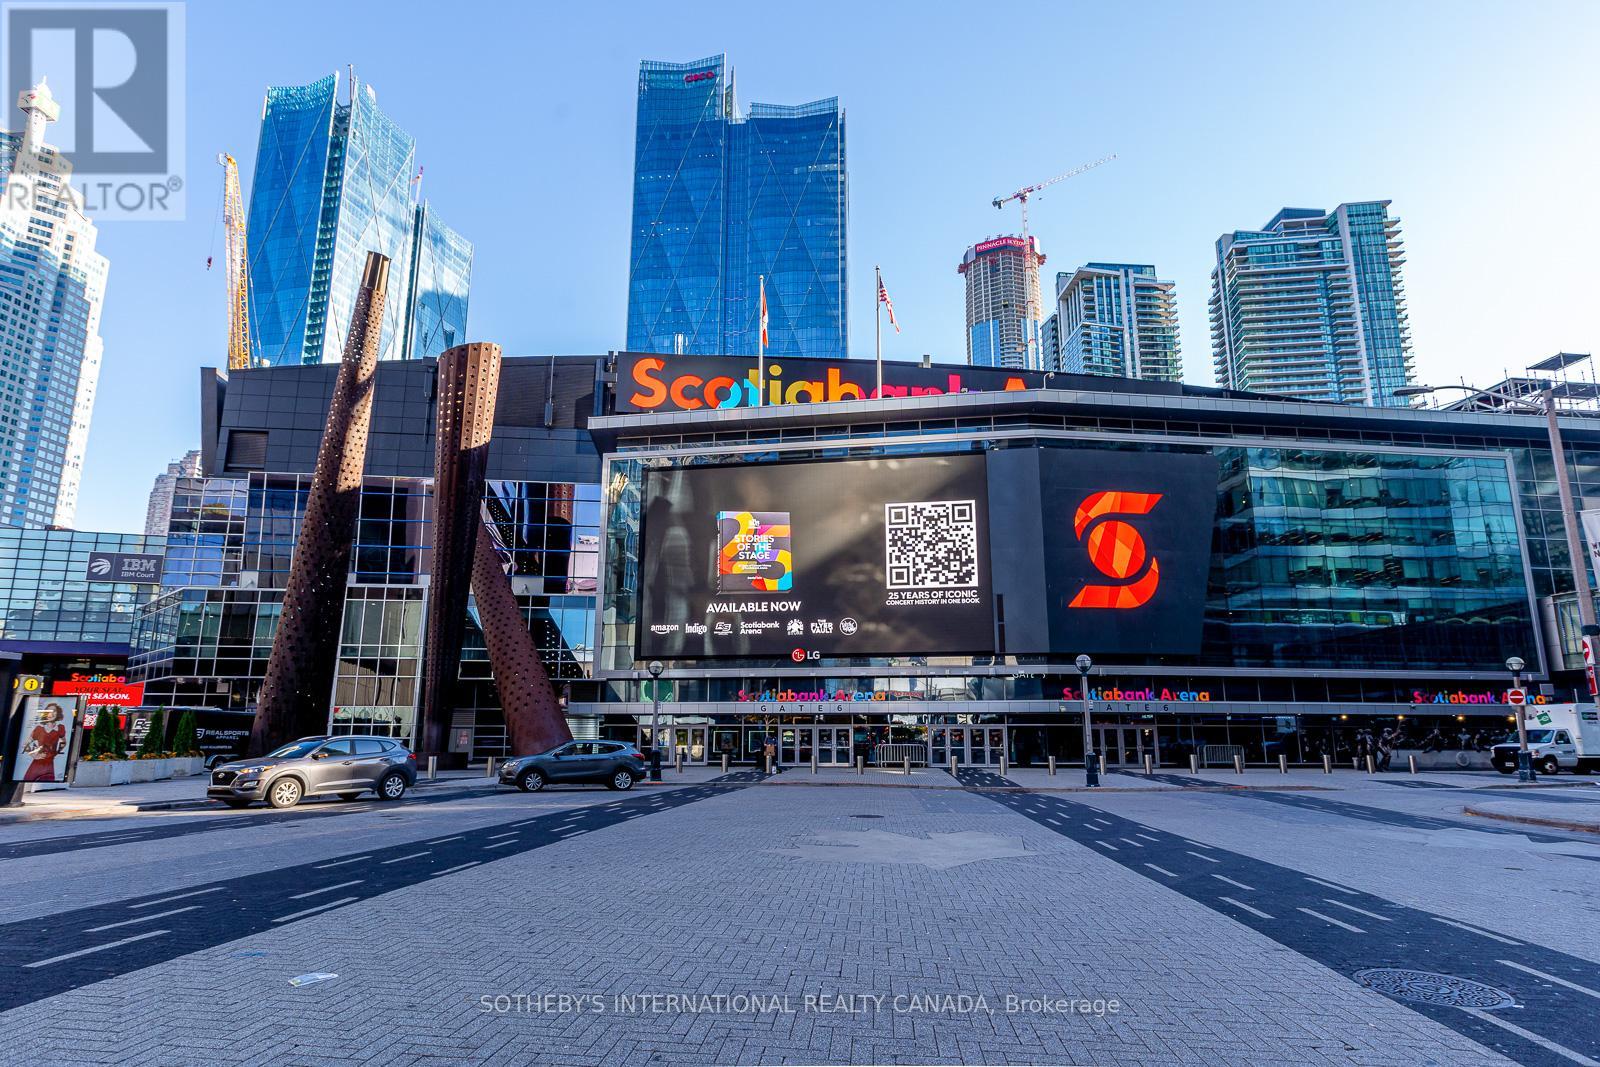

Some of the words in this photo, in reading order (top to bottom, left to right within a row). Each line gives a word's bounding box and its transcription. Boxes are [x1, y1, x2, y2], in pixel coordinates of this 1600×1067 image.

[734, 534, 775, 543] STORIES
[737, 543, 751, 551] OF
[754, 543, 772, 551] THE
[738, 551, 771, 560] STAGE
[122, 558, 157, 572] IBM
[888, 592, 899, 600] 25
[900, 591, 930, 599] YEARS
[931, 591, 943, 599] OF
[945, 590, 978, 598] ICONIC
[706, 602, 769, 613] AVAILABLE
[770, 601, 801, 612] NOW
[650, 624, 679, 634] amazon
[685, 622, 708, 635] Indigo
[740, 620, 780, 629] Scotiabank
[807, 650, 820, 660] LG
[92, 692, 130, 700] SEASON.
[738, 688, 830, 702] Scotiabank
[834, 688, 886, 702] Arena
[1161, 688, 1210, 701] Arena
[760, 704, 824, 712] GATE
[837, 704, 843, 712] 6
[1163, 703, 1169, 711] 6
